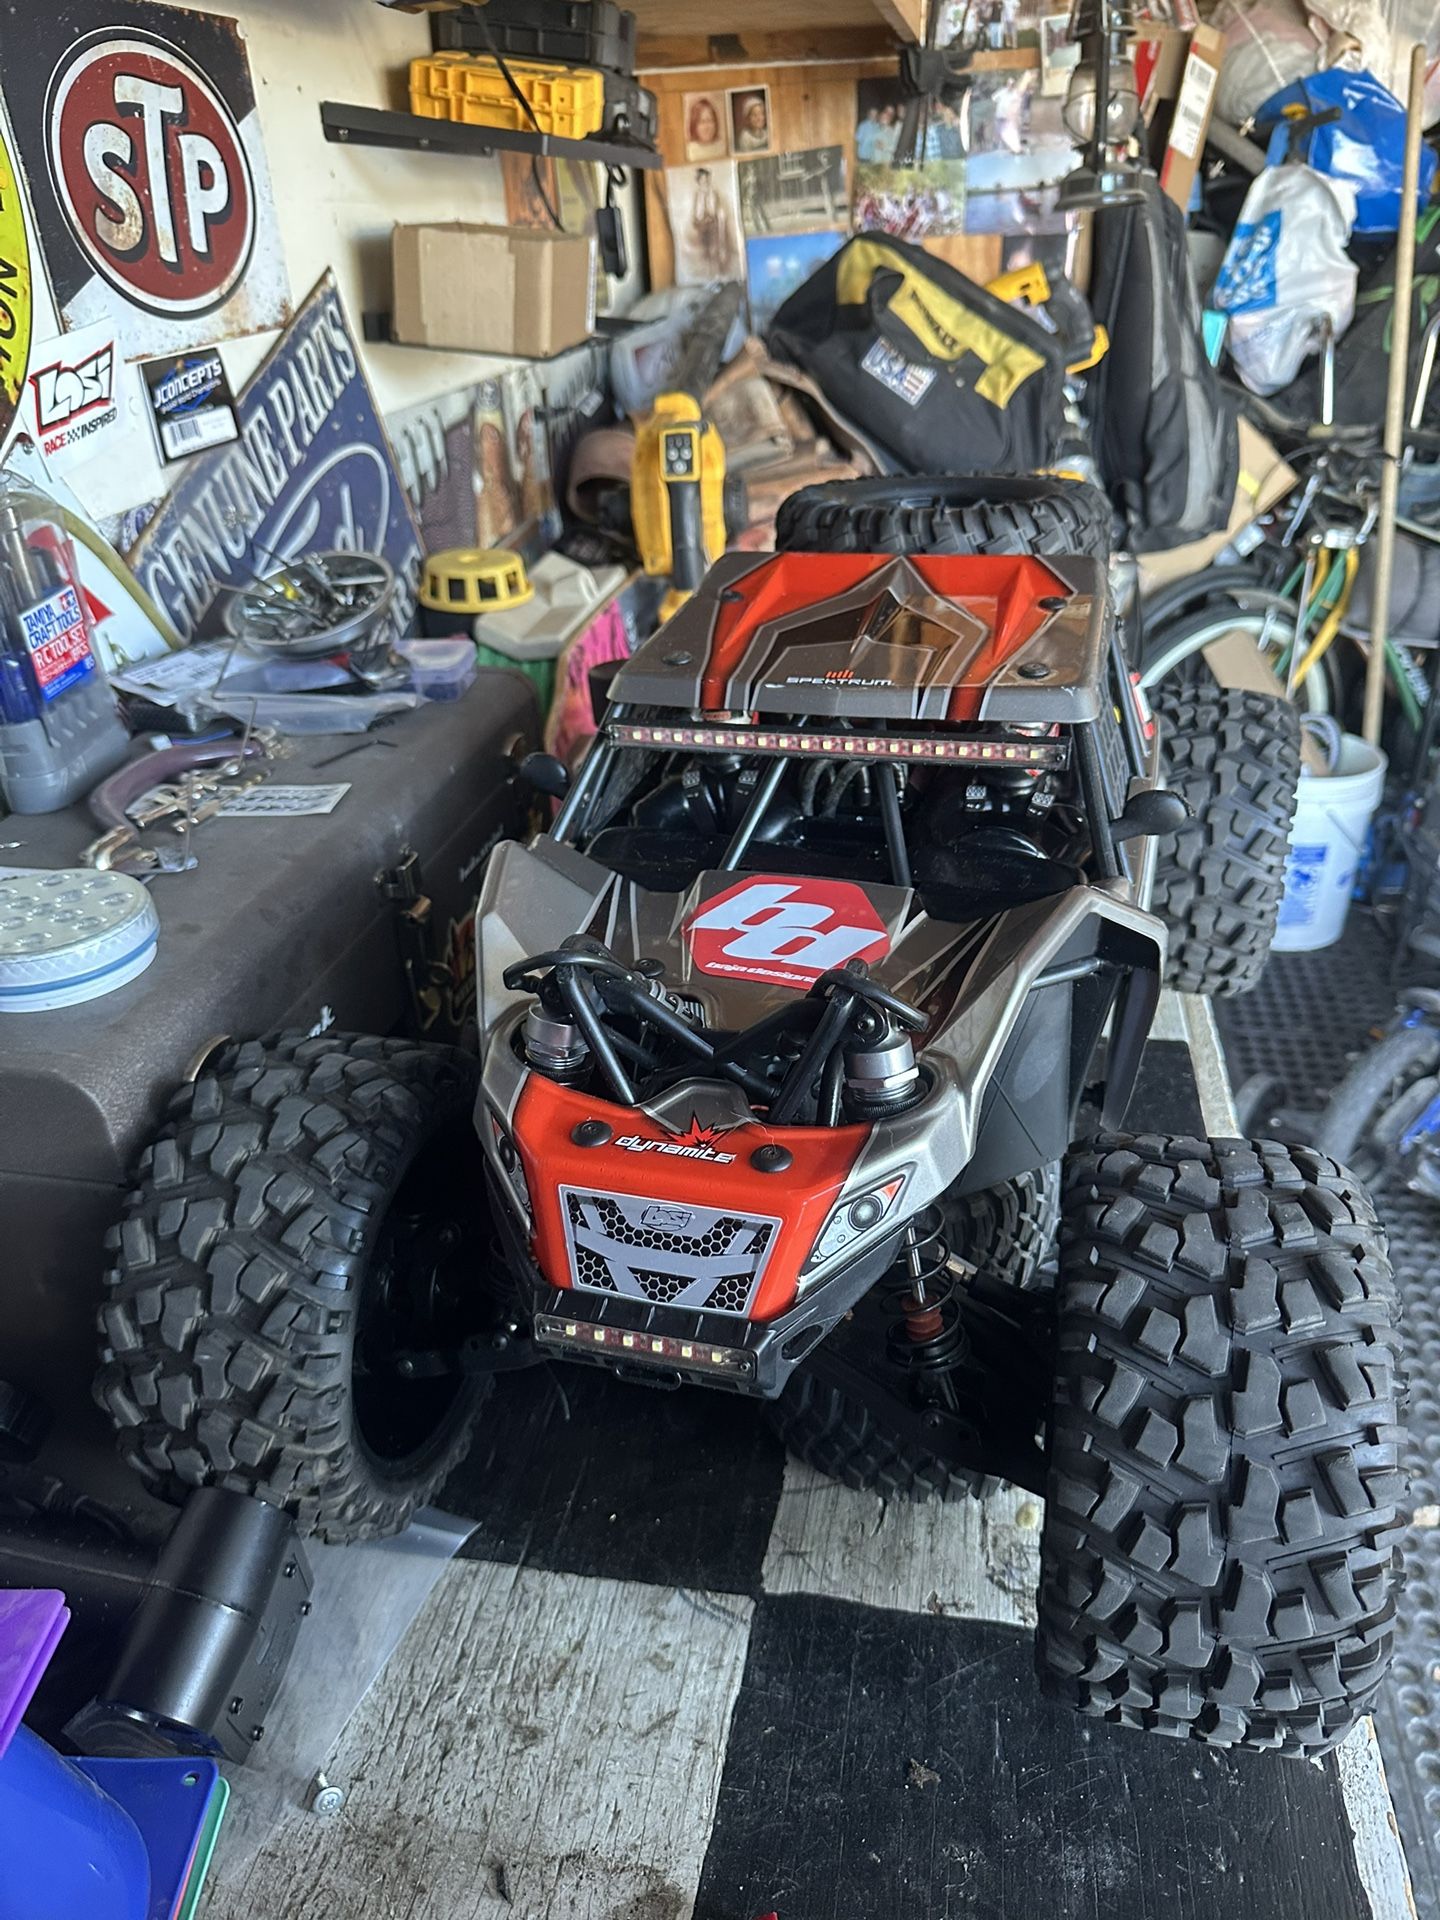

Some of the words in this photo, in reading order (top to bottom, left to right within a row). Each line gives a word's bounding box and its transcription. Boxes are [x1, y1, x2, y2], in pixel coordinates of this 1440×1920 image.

[83, 75, 229, 263] STP
[153, 358, 222, 409] JCONCEPTS
[44, 432, 67, 457] RACE
[81, 407, 117, 438] INSPIRED
[148, 405, 289, 646] GENUINE
[267, 303, 356, 467] PARTS
[23, 603, 57, 632] TAMIYA
[29, 621, 58, 649] CRAFT
[56, 606, 82, 632] TOOLS
[786, 676, 893, 686] SPEKTRUM
[614, 1135, 737, 1164] dynamite
